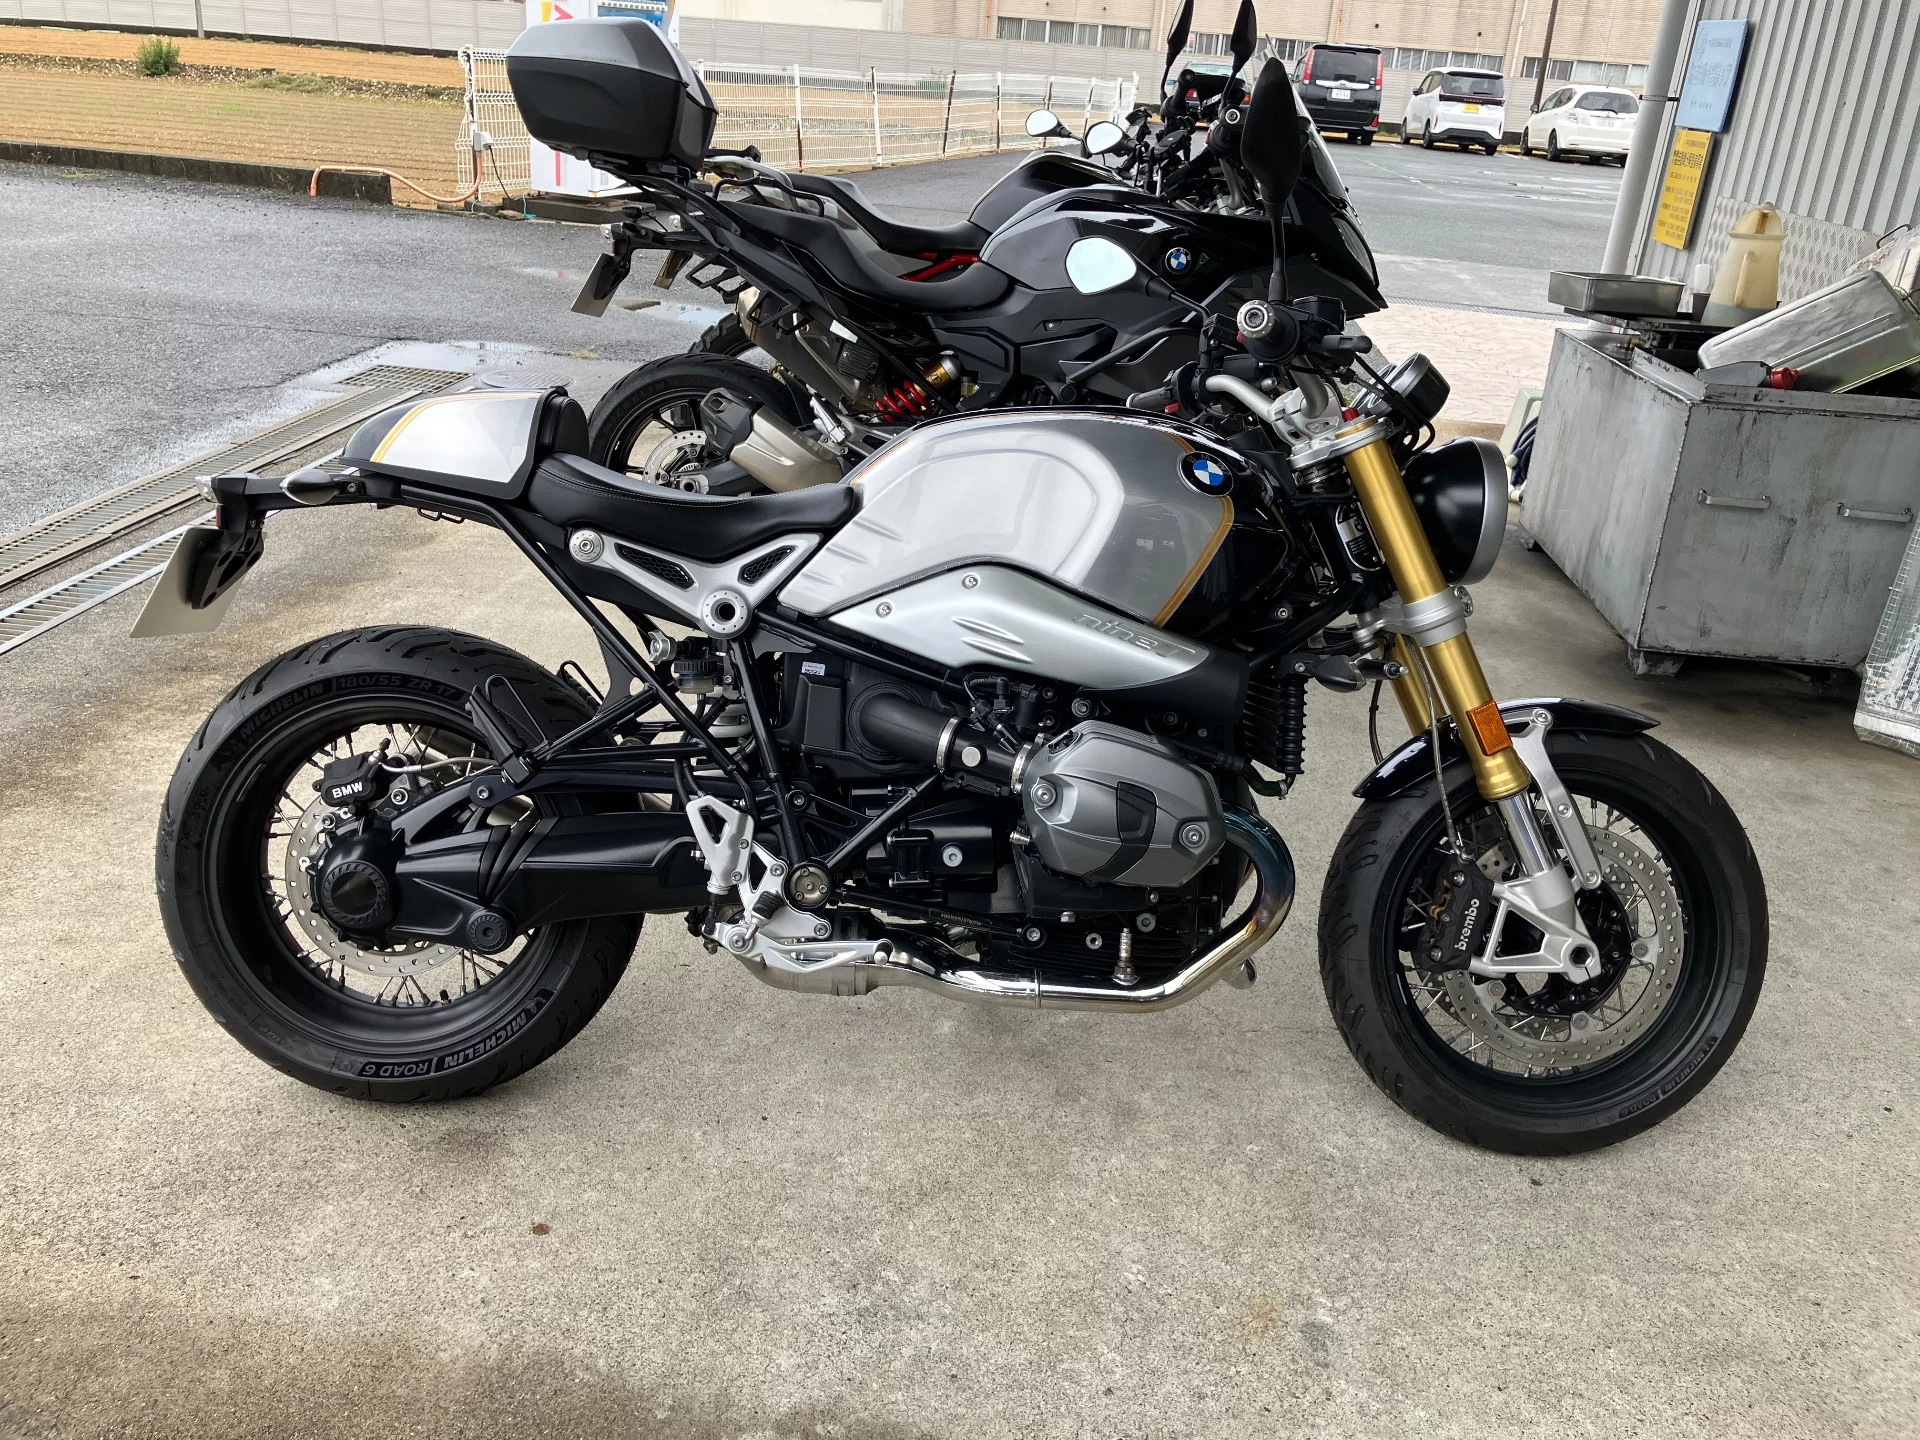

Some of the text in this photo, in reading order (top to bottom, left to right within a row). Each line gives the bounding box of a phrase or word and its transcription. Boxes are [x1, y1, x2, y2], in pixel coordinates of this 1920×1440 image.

[1171, 248, 1192, 261] BMW
[1187, 454, 1228, 473] BMW
[239, 675, 458, 740] MICHELIN 180/55 ZR 17
[331, 781, 363, 799] BMW
[1454, 898, 1480, 951] brembo
[362, 1011, 529, 1078] MICHELIN ROAD 6
